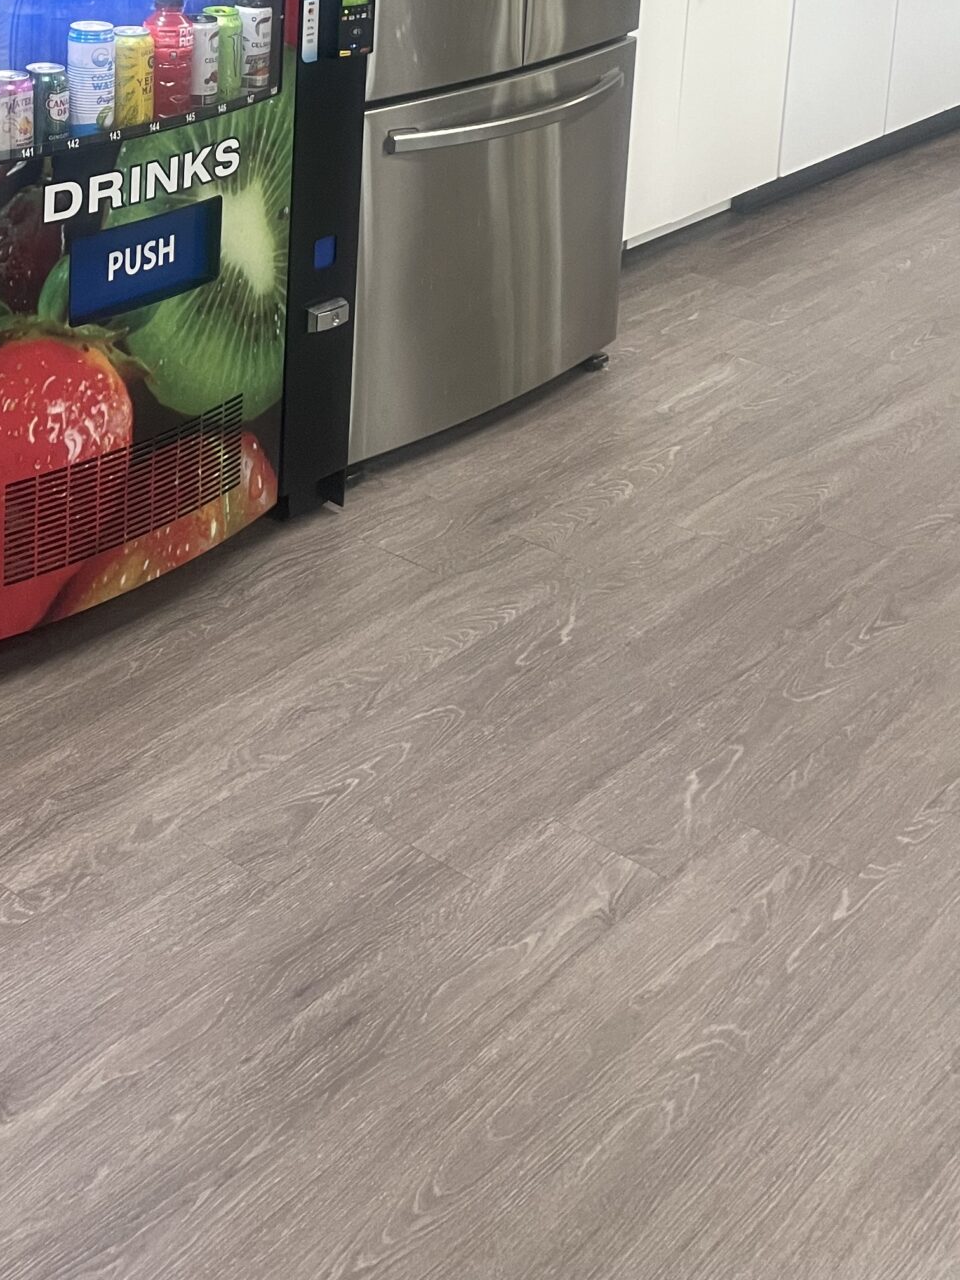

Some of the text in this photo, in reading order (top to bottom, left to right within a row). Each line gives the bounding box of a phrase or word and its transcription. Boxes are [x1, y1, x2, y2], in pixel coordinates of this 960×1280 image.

[185, 111, 196, 122] 145
[149, 121, 160, 132] 144
[109, 130, 121, 141] 143
[67, 138, 80, 150] 142
[21, 147, 34, 158] 141
[42, 137, 241, 223] DRINKS
[106, 234, 176, 283] PUSH
